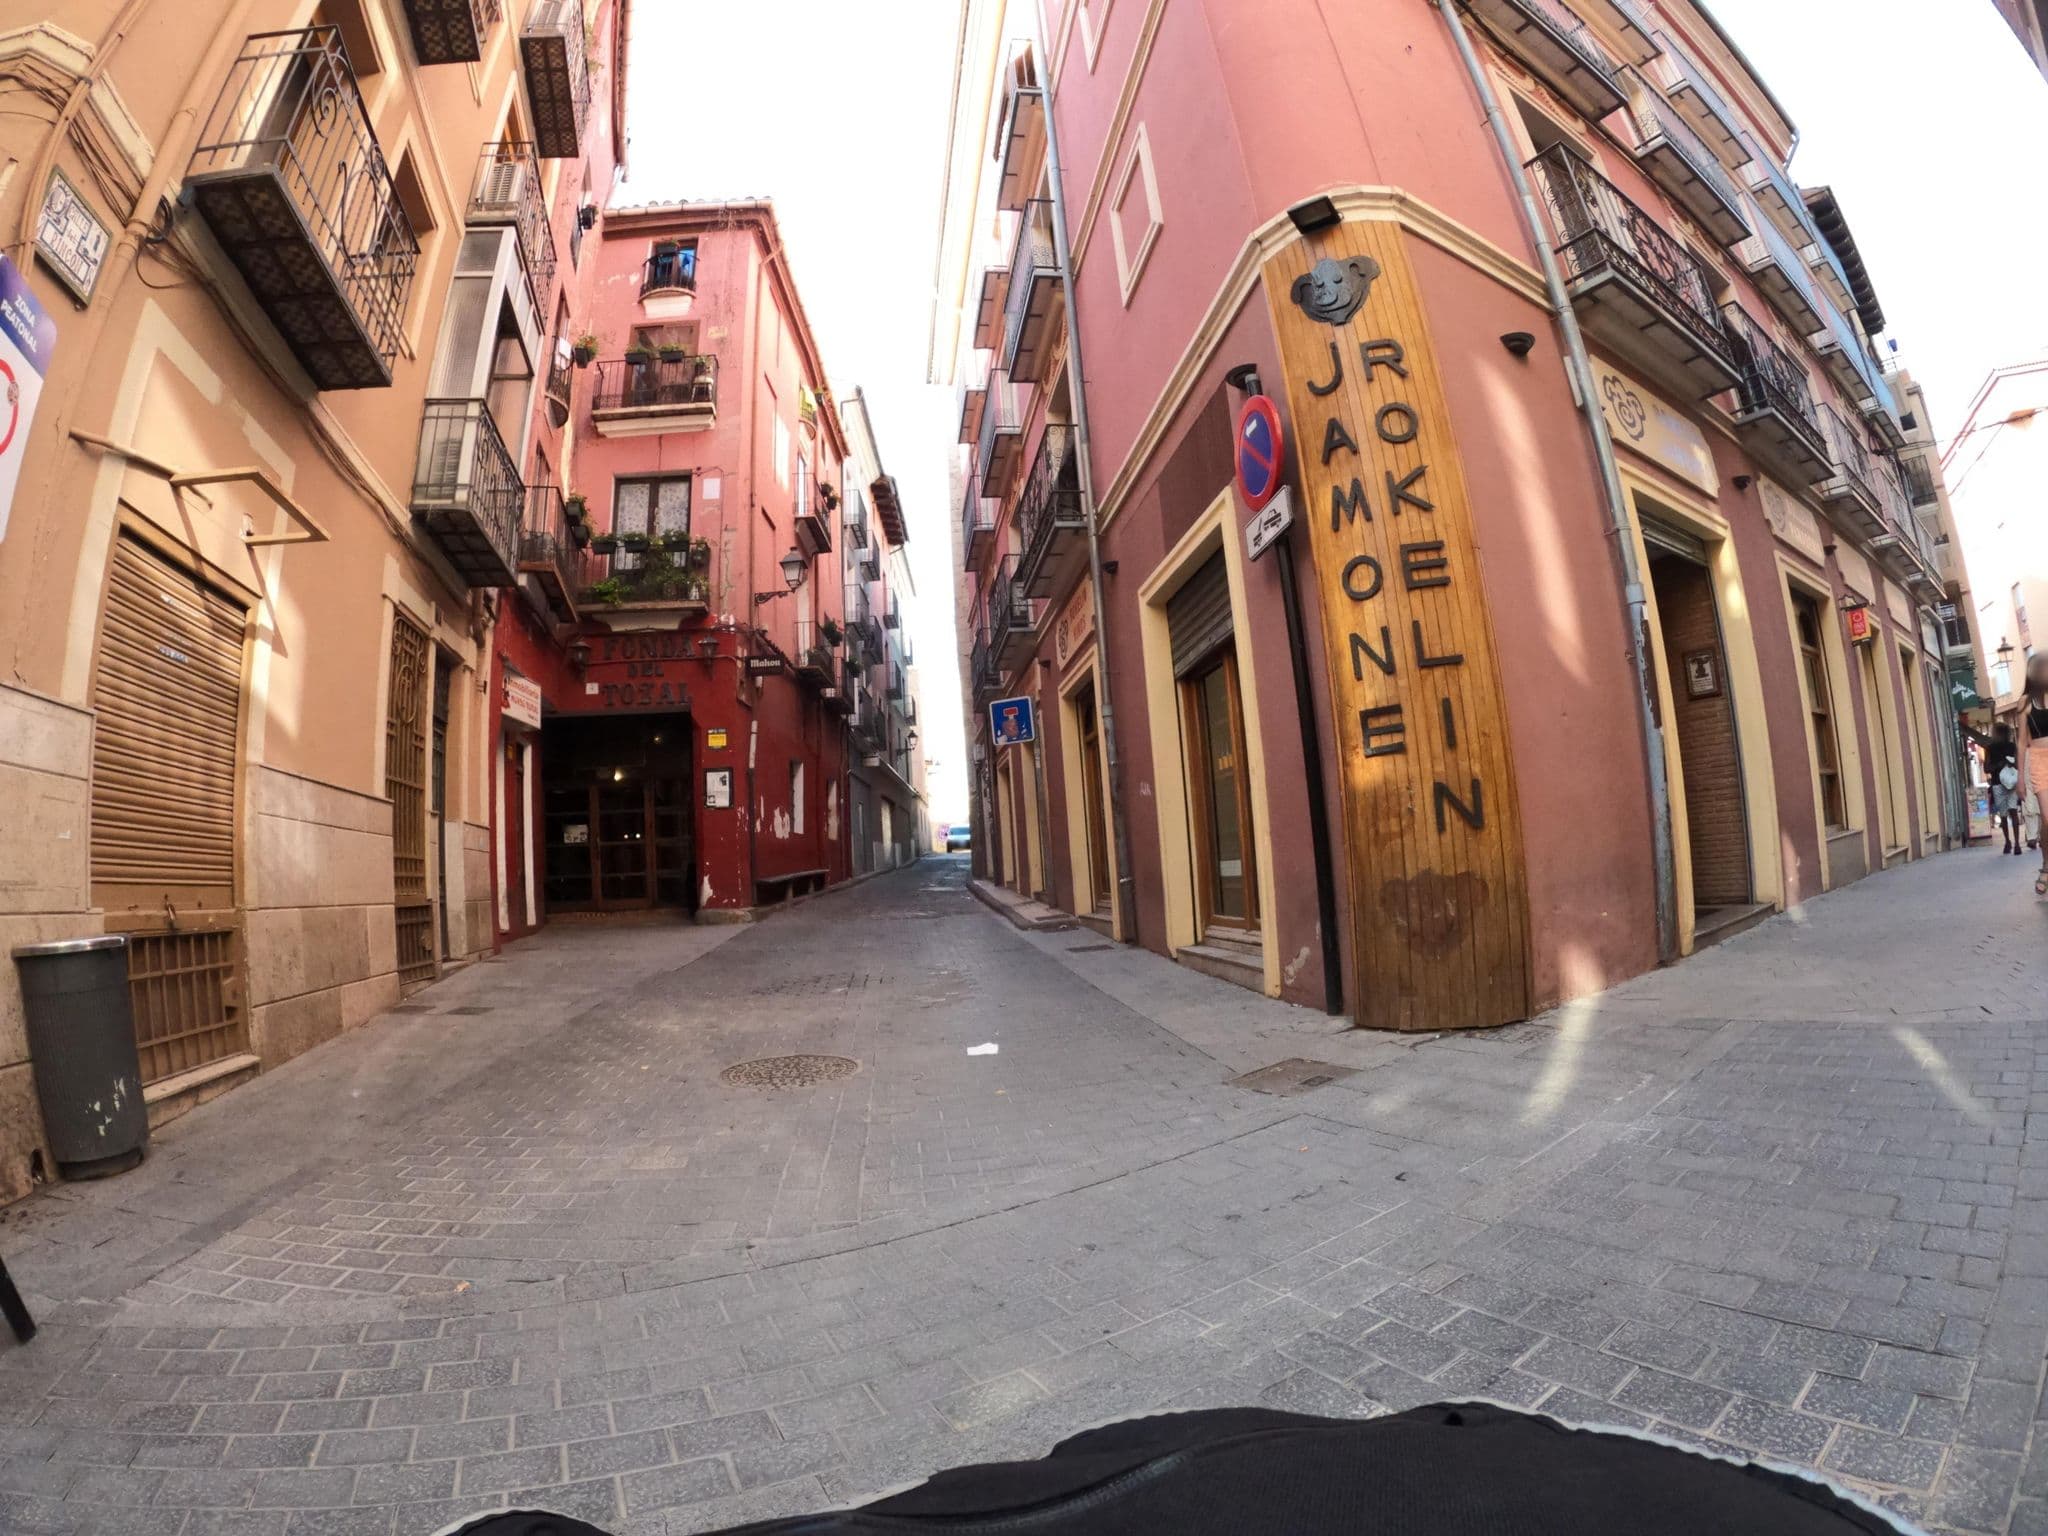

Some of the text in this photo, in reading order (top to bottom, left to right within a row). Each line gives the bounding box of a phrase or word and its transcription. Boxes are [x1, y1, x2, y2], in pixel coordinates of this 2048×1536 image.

[15, 294, 36, 328] ZONA
[1, 298, 37, 353] PEATONAL
[1360, 339, 1484, 834] ROKELIN
[603, 634, 696, 660] FONDA
[628, 661, 664, 677] DEL
[750, 658, 781, 668] Mahou
[602, 682, 692, 706] TOZAL
